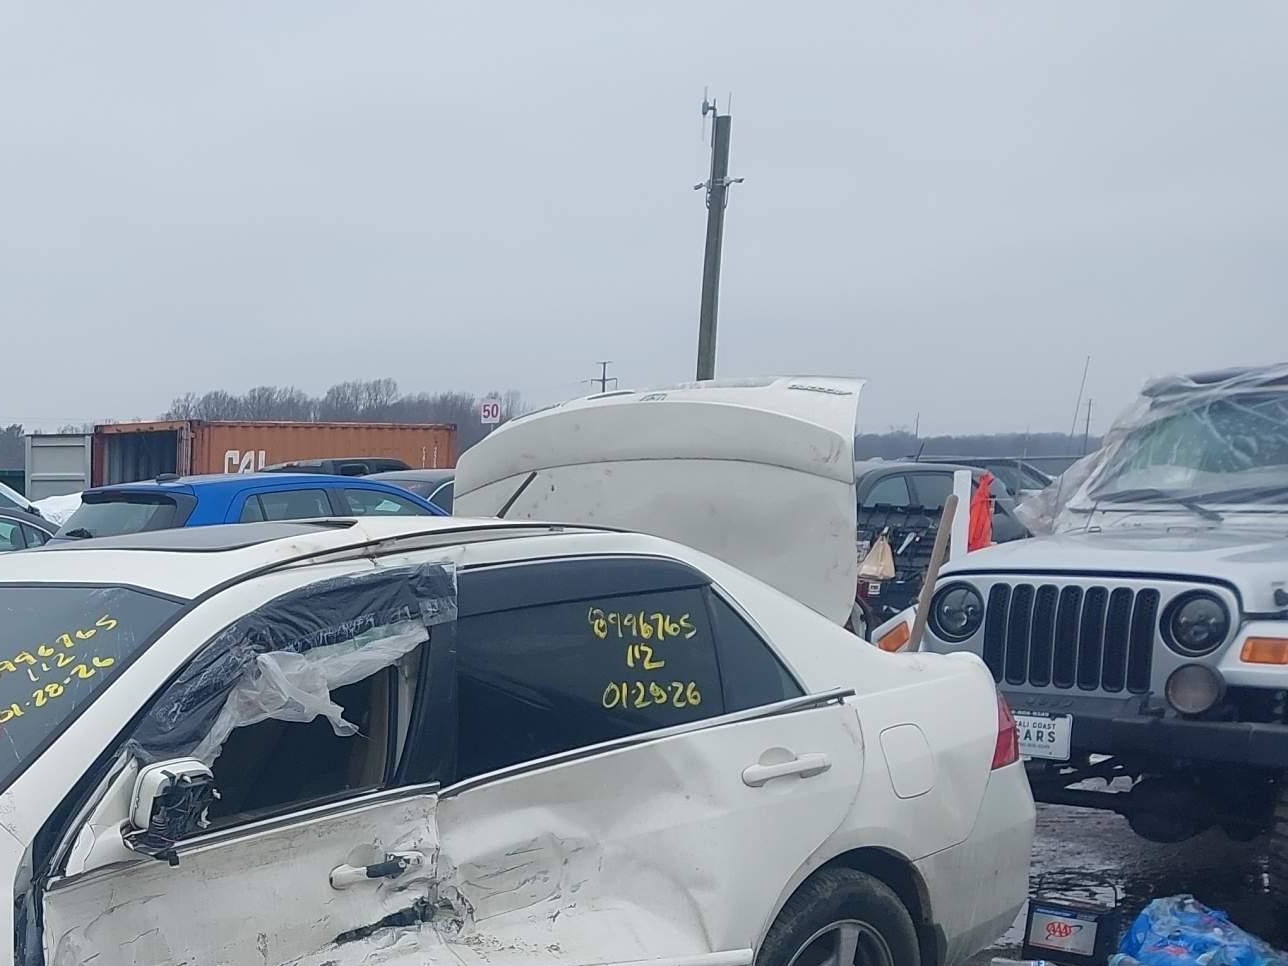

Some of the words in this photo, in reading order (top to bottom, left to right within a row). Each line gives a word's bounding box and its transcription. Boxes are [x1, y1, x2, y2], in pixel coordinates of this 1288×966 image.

[483, 403, 498, 418] 50
[588, 607, 697, 640] 8996765
[627, 643, 665, 670] 112
[1032, 721, 1056, 730] COAST
[1047, 922, 1072, 937] AAA
